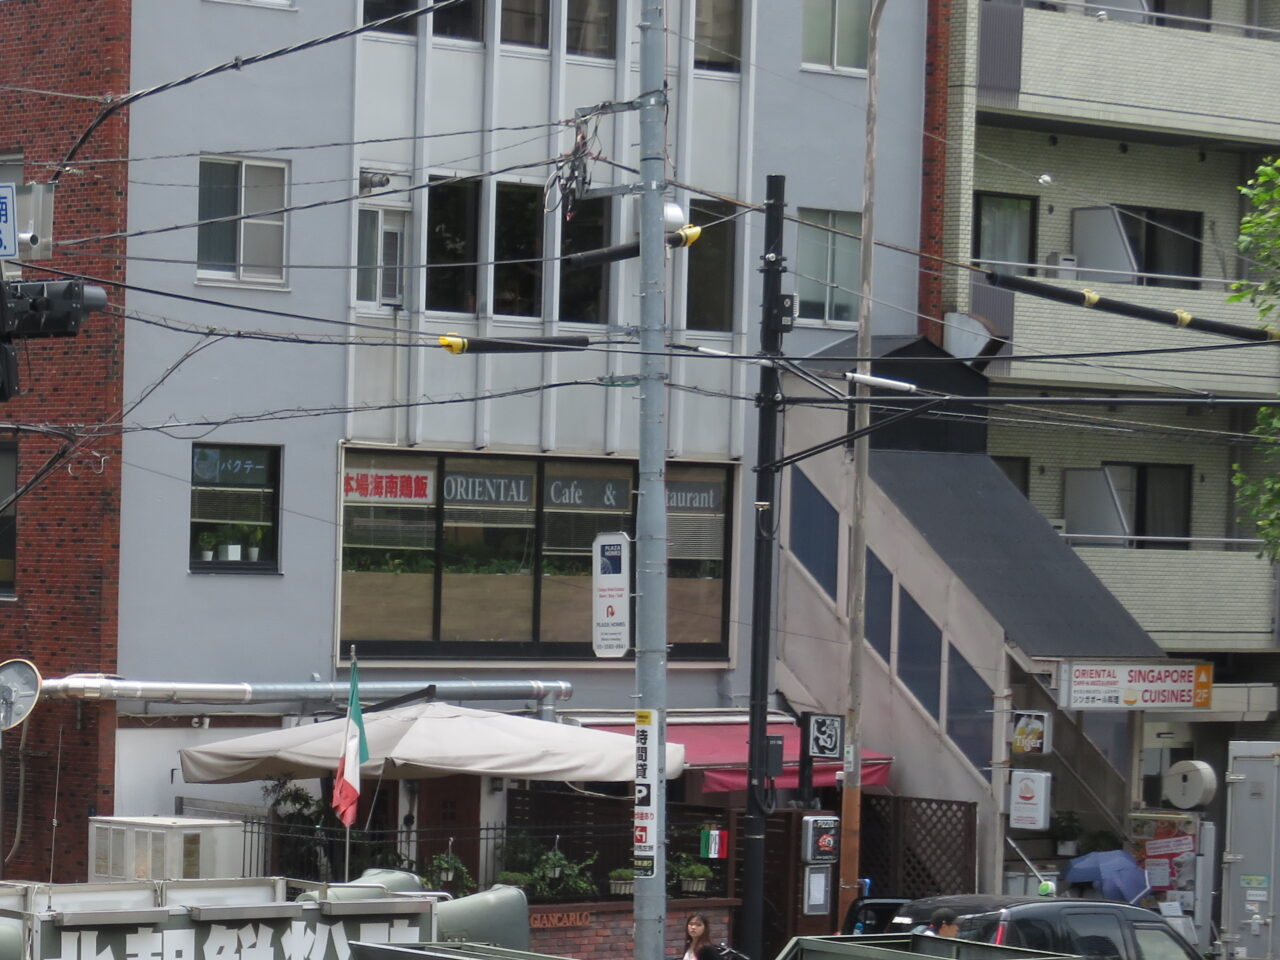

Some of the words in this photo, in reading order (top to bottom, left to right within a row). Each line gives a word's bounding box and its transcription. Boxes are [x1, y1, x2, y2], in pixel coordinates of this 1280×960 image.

[443, 476, 529, 502] ORIENTAL
[550, 481, 583, 505] Cafe
[603, 482, 617, 507] &
[666, 488, 715, 509] taurant
[1073, 668, 1117, 679] ORIENTAL
[1127, 669, 1194, 684] SINGAPORE
[1141, 688, 1193, 704] CUISINES
[1196, 689, 1209, 703] 2F
[1015, 735, 1043, 752] Tiger
[530, 912, 591, 929] GIANCARLO
